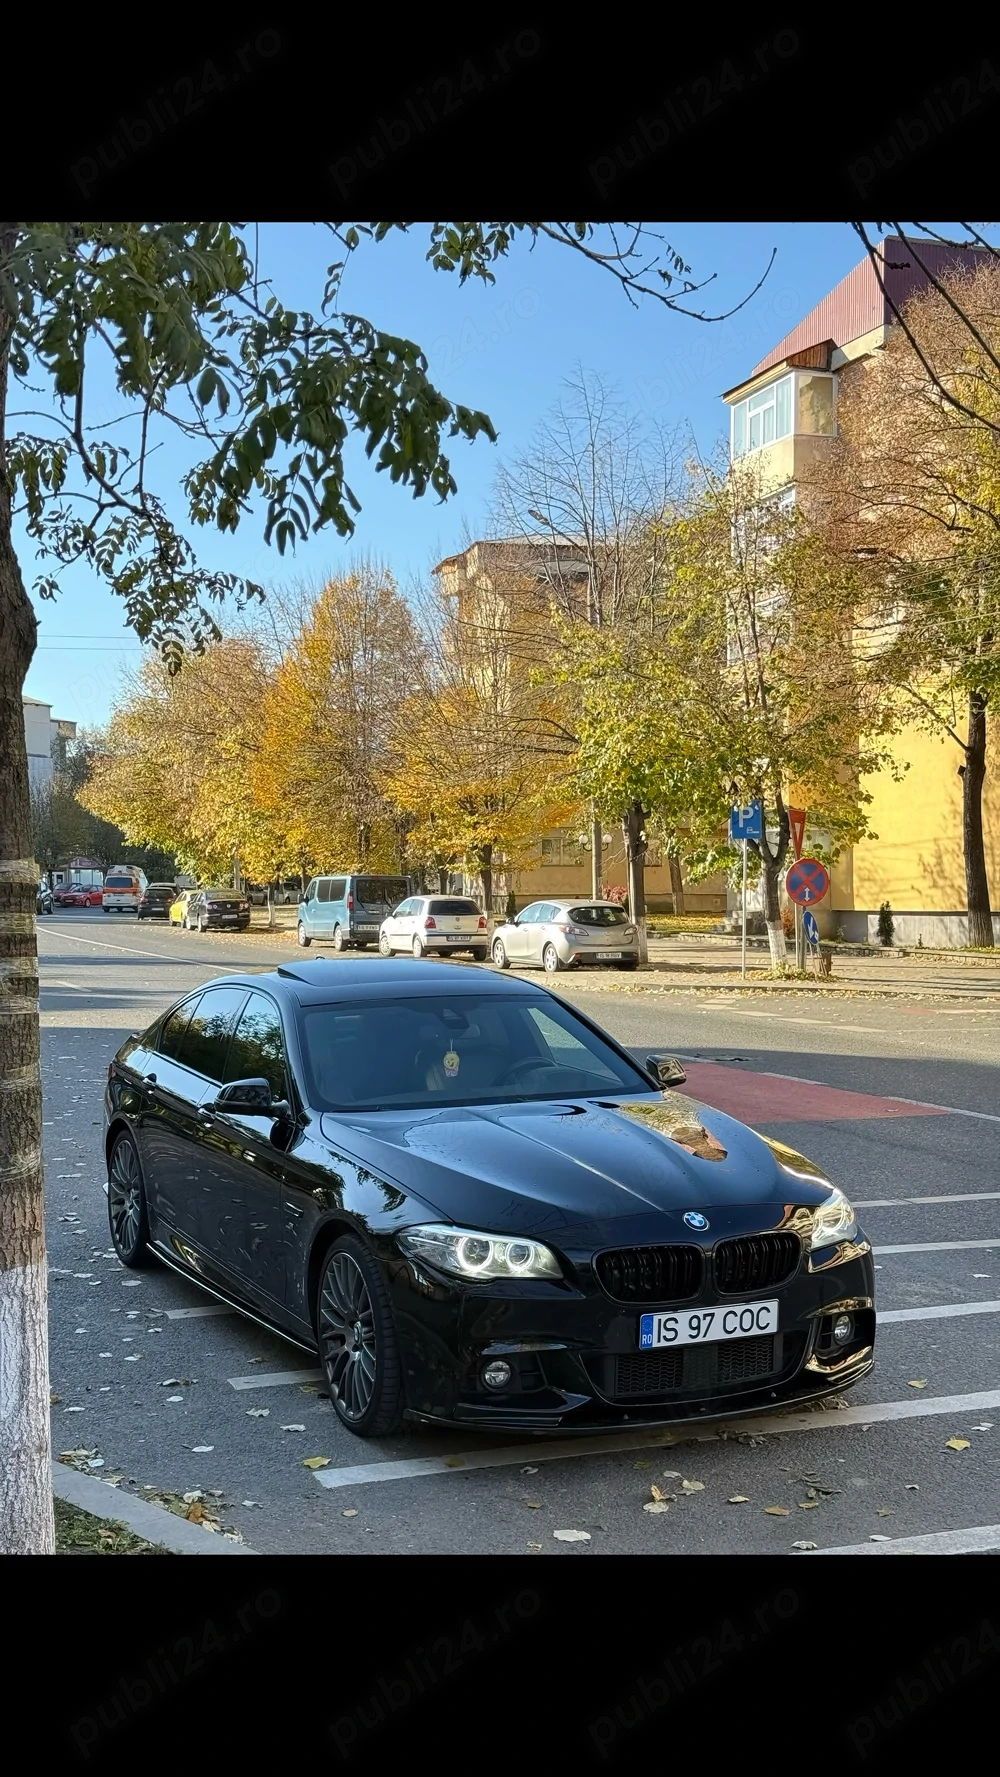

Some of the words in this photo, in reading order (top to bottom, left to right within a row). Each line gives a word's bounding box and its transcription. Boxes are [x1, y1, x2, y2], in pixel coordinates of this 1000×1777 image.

[739, 806, 754, 828] P
[657, 1316, 679, 1344] IS
[688, 1312, 716, 1340] 97
[722, 1306, 771, 1335] COC
[642, 1334, 653, 1345] RO
